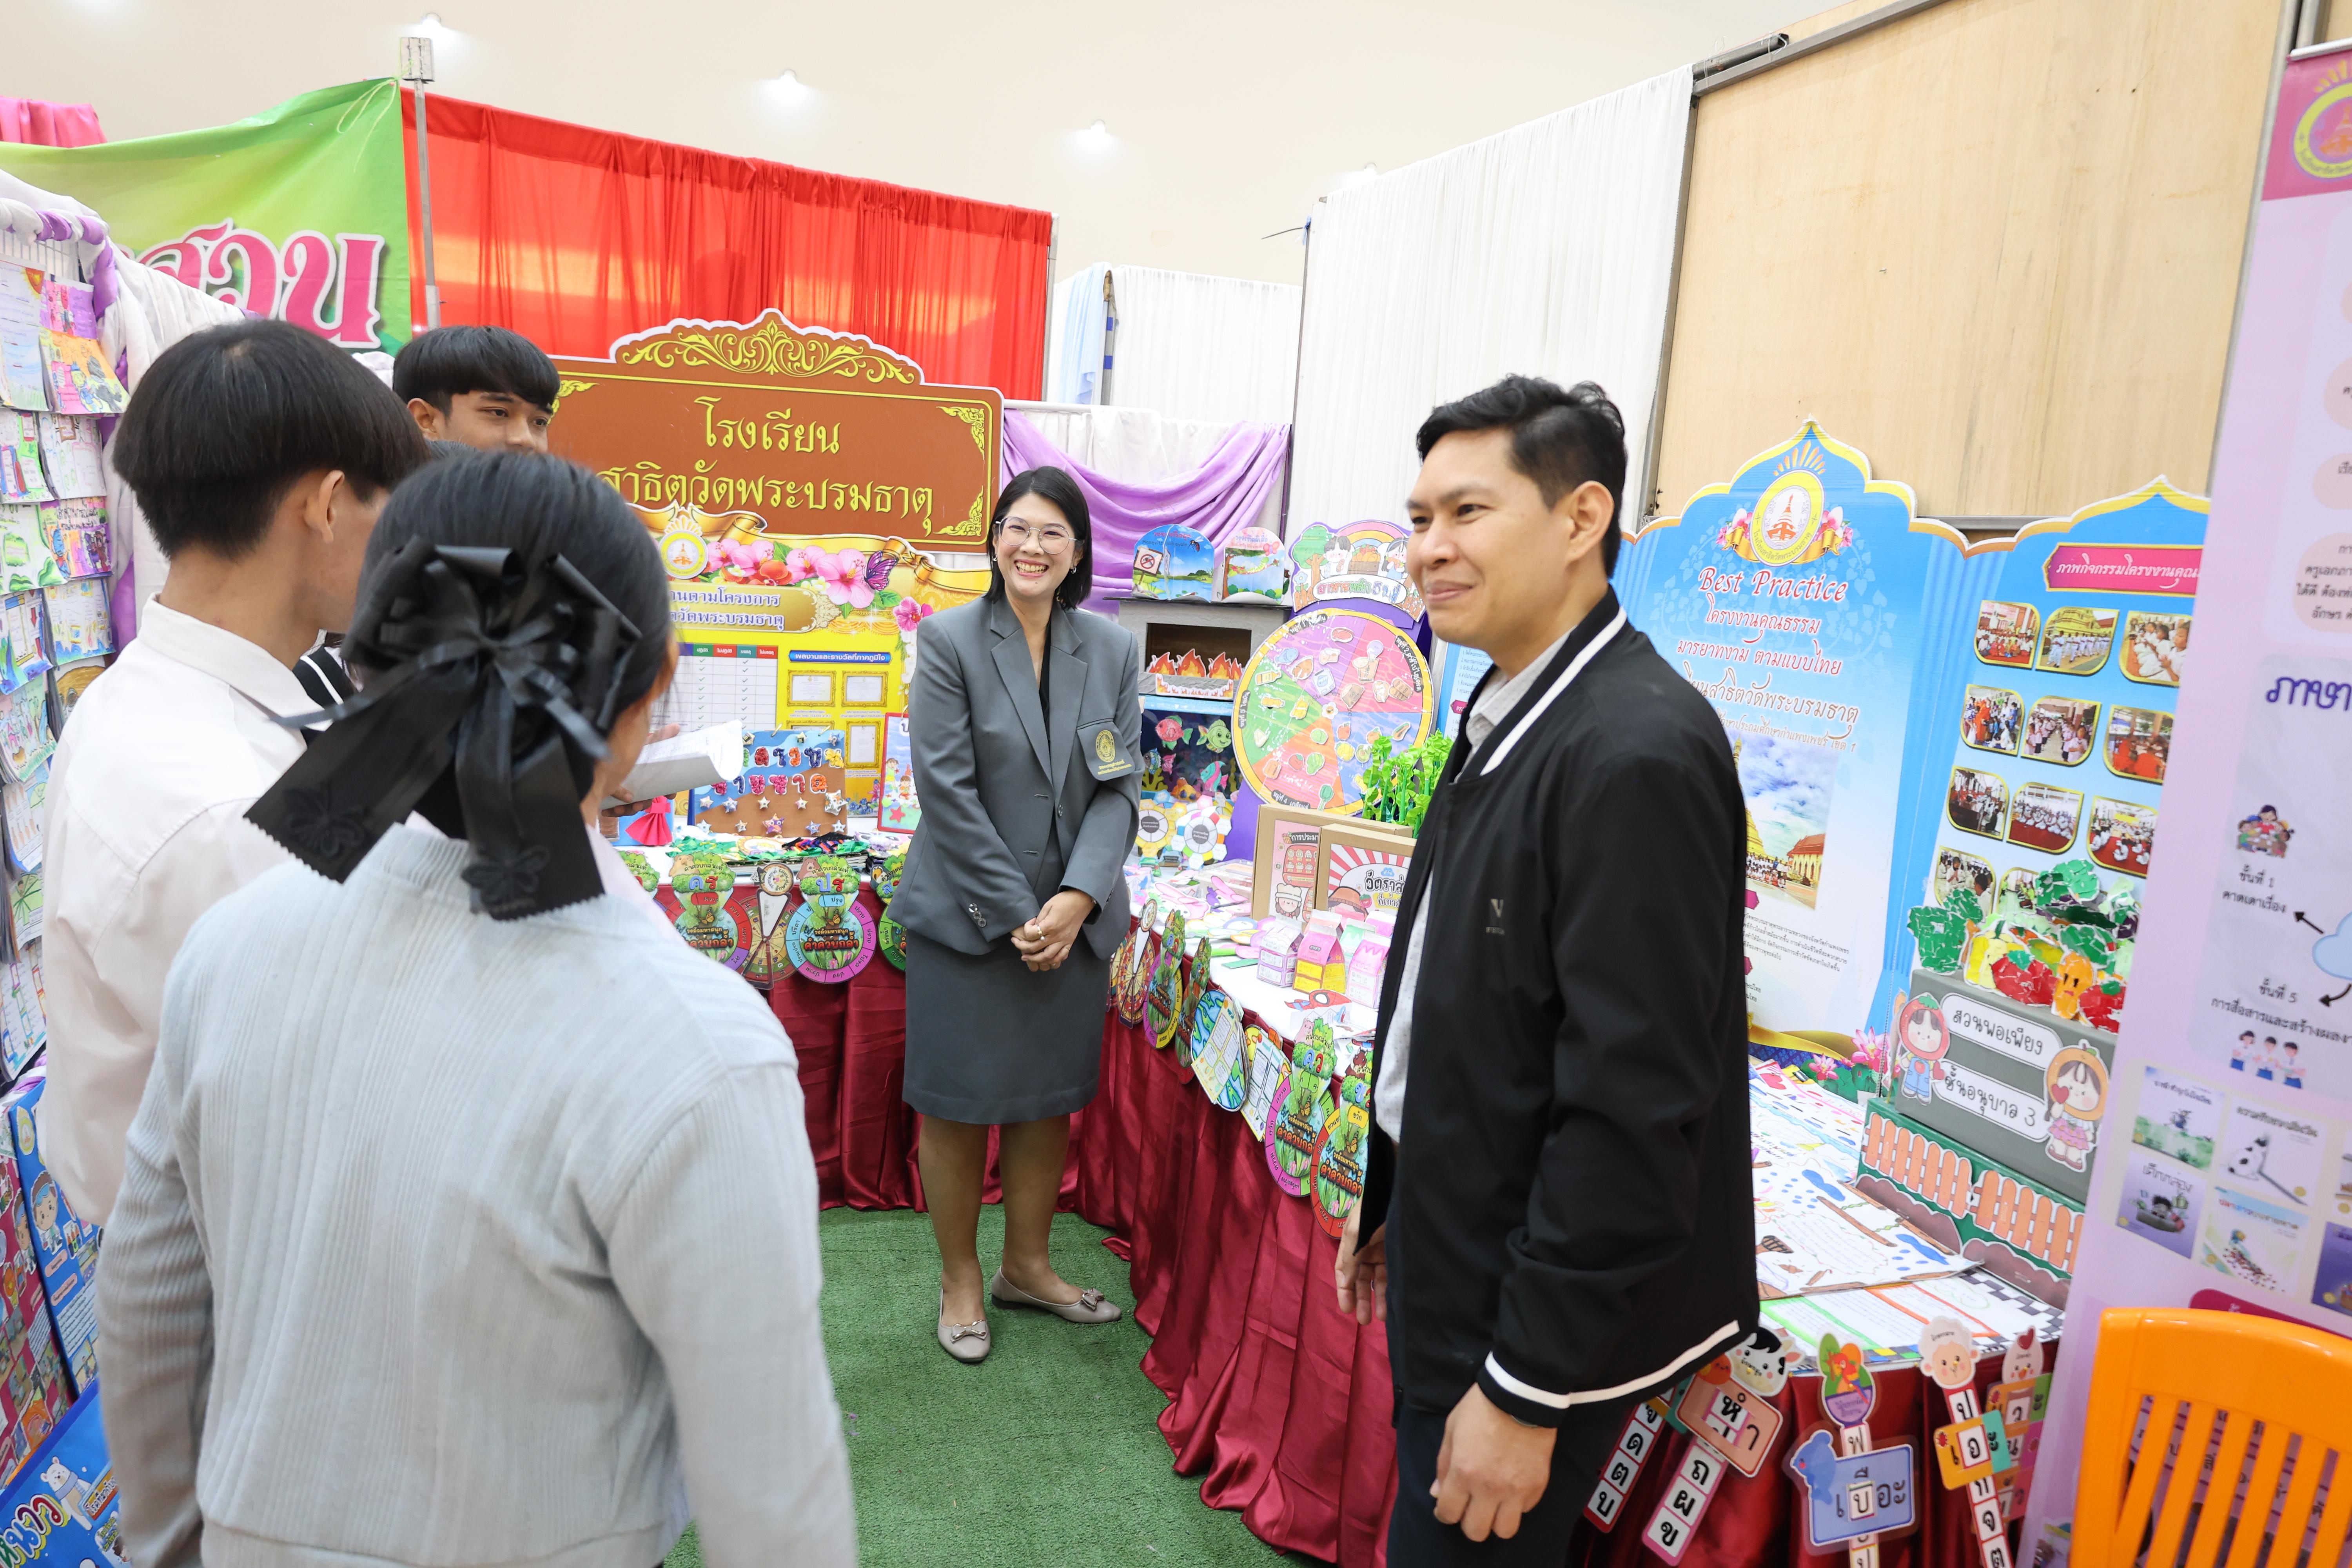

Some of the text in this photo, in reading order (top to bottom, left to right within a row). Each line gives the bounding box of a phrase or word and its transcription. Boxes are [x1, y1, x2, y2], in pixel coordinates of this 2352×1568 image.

[694, 396, 841, 454] โรงเรียน
[2056, 553, 2201, 589] ภาพกิจกรรมโครงงานคุณ
[1317, 578, 1371, 594] อาหารหลัก
[1372, 581, 1383, 595] 5
[1699, 567, 1849, 602] Best Practice
[1705, 592, 1821, 644] โครงงานคุณธรรม
[795, 653, 886, 662] ผลงานและรางวัลที่ภาคภูมิใจ
[1677, 639, 1843, 676] มารยาทงาม ตามแบบไทย
[2265, 676, 2352, 711] ภาษา
[812, 862, 849, 875] คำควบกล้ำแท้
[689, 875, 718, 890] คร
[816, 873, 845, 892] ปร
[2222, 890, 2287, 914] คาดเดาเรื่อง
[804, 931, 859, 952] คำควบกล้ำ
[2288, 992, 2298, 1004] 5
[1953, 1010, 2043, 1056] สวนพอเพียง
[1945, 1065, 2036, 1127] ชั้นอนุบาล 3
[1288, 1115, 1313, 1133] วงล้อมหาสนุก
[1333, 1151, 1359, 1171] วงล้อมหาสนุก
[1320, 1159, 1363, 1198] คำควบกล้ำ
[1626, 1432, 1644, 1457] ด
[1611, 1462, 1630, 1487] ต
[1599, 1491, 1615, 1518] บ
[1661, 1459, 1710, 1547] ถ ผ ข
